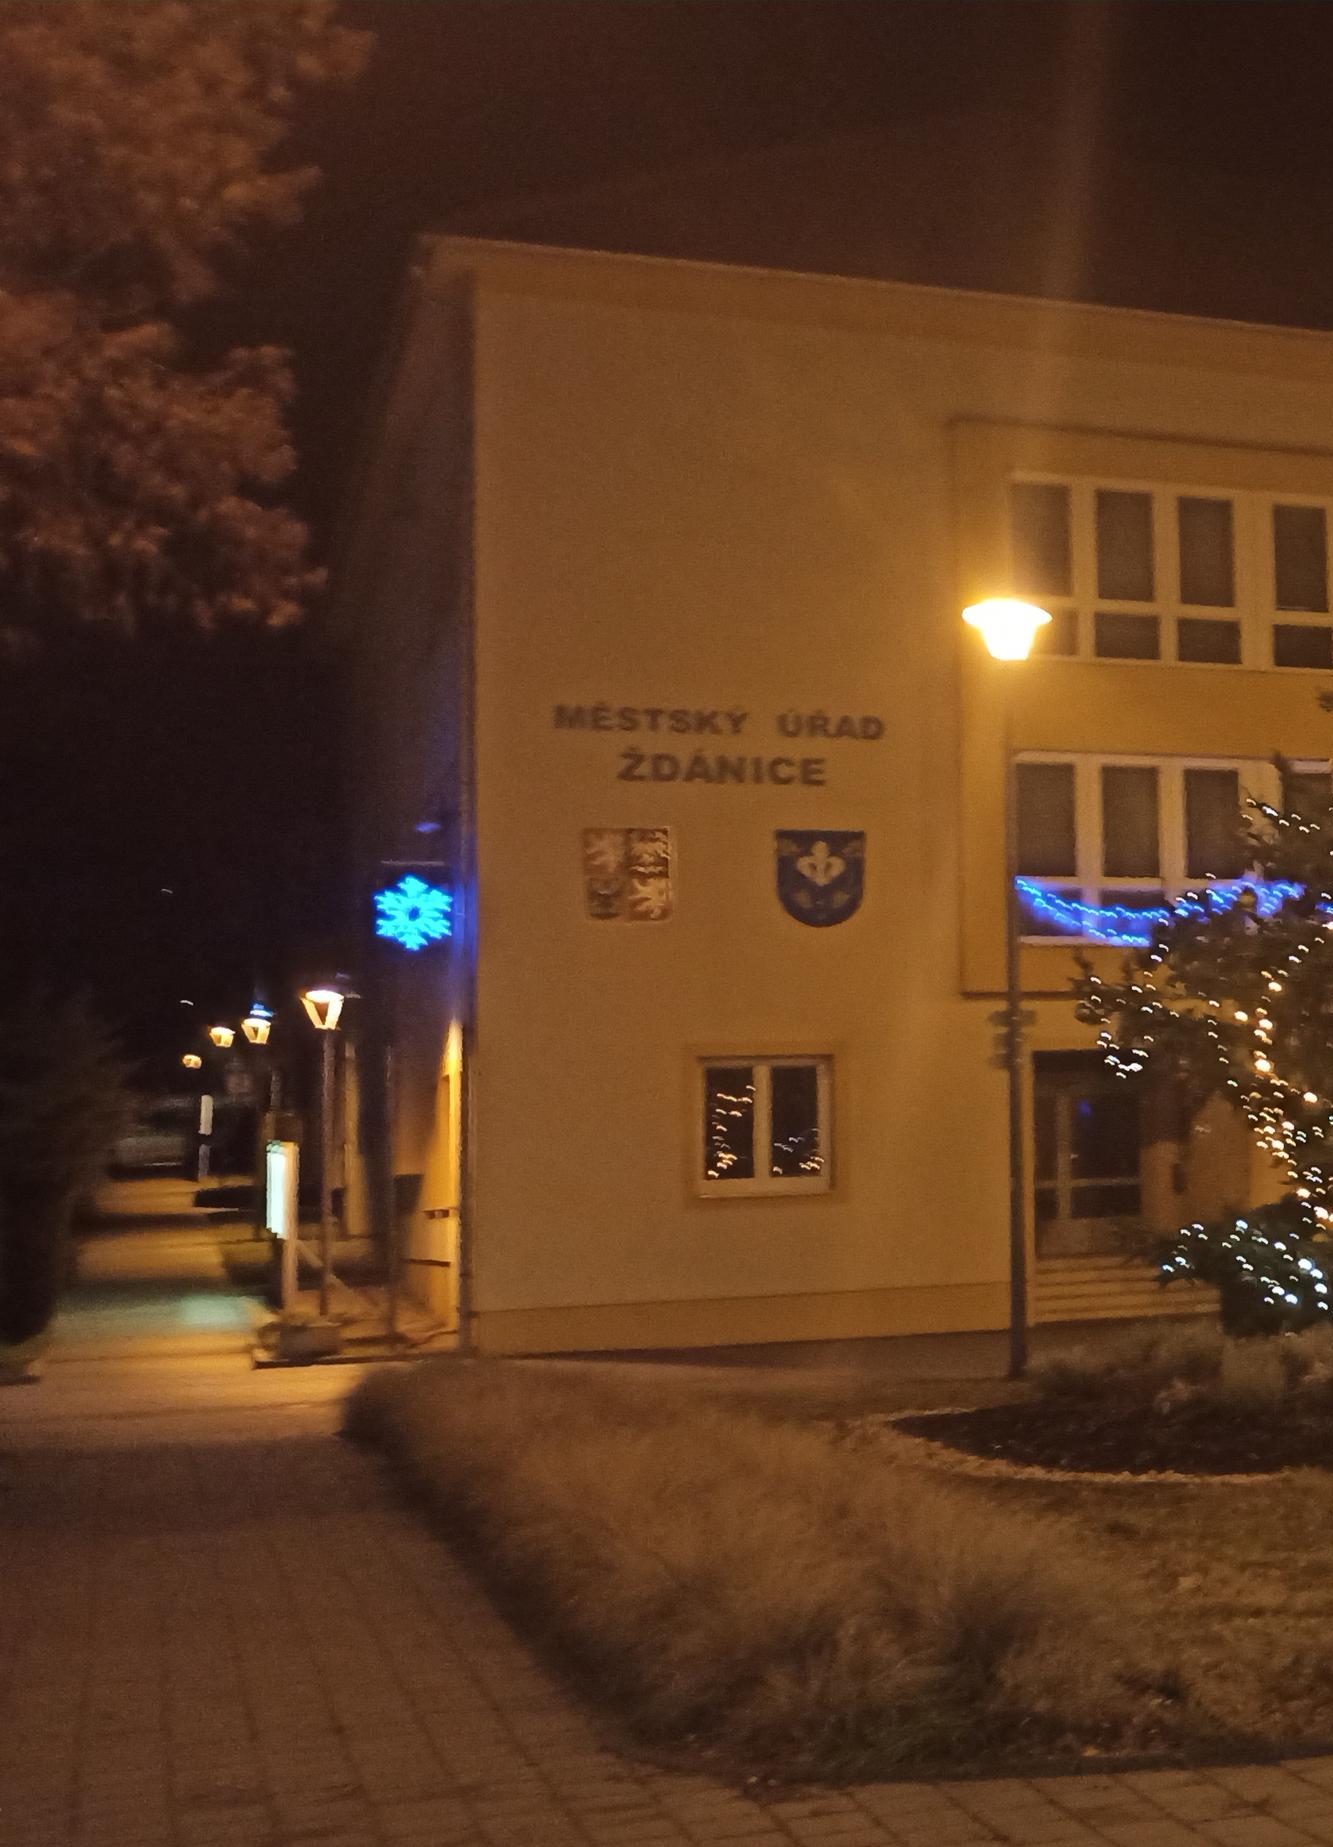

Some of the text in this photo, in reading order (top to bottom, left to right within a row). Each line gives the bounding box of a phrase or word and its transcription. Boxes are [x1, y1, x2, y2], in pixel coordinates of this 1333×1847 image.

[553, 701, 886, 740] MĚSTSKÝ ÚŘAD
[616, 745, 827, 786] ŽDÁNICE
